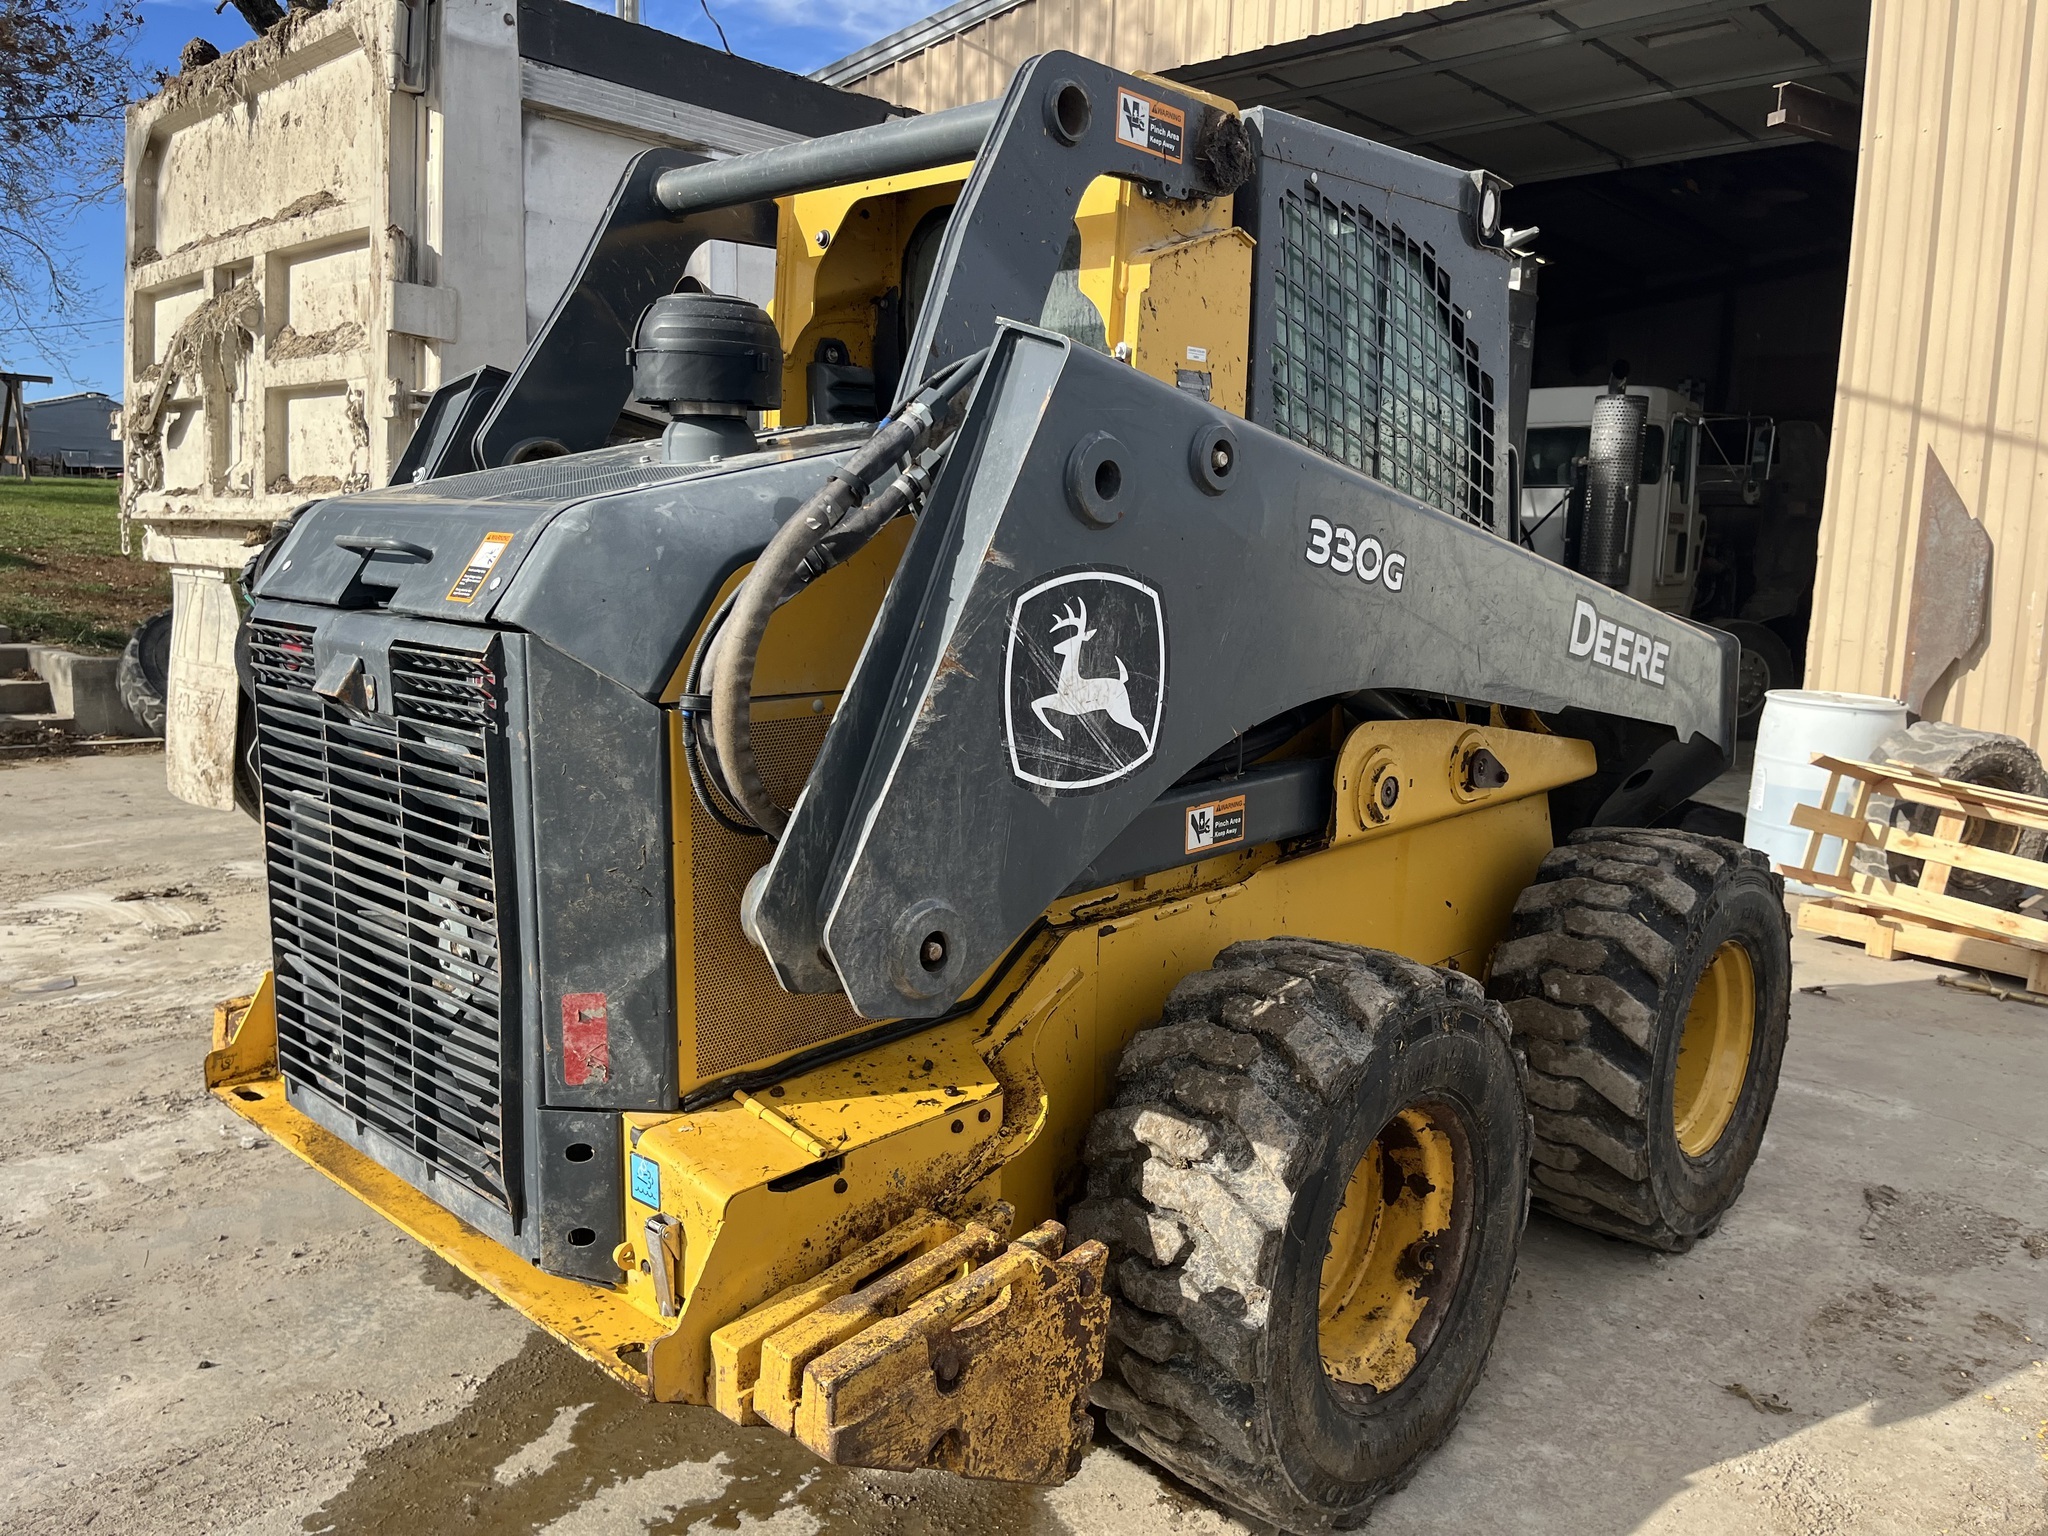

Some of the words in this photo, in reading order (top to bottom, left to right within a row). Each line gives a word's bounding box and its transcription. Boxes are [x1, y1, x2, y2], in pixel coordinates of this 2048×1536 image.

[1157, 107, 1182, 122] WARNING
[1150, 124, 1166, 136] Pinch
[1167, 130, 1180, 142] Area
[1150, 136, 1162, 146] Keep
[1163, 140, 1175, 151] Away
[1305, 517, 1407, 591] 330G
[1568, 599, 1670, 686] DEERE
[1221, 800, 1242, 811] WARNING
[1215, 820, 1229, 829] Pinch
[1230, 817, 1241, 825] Area
